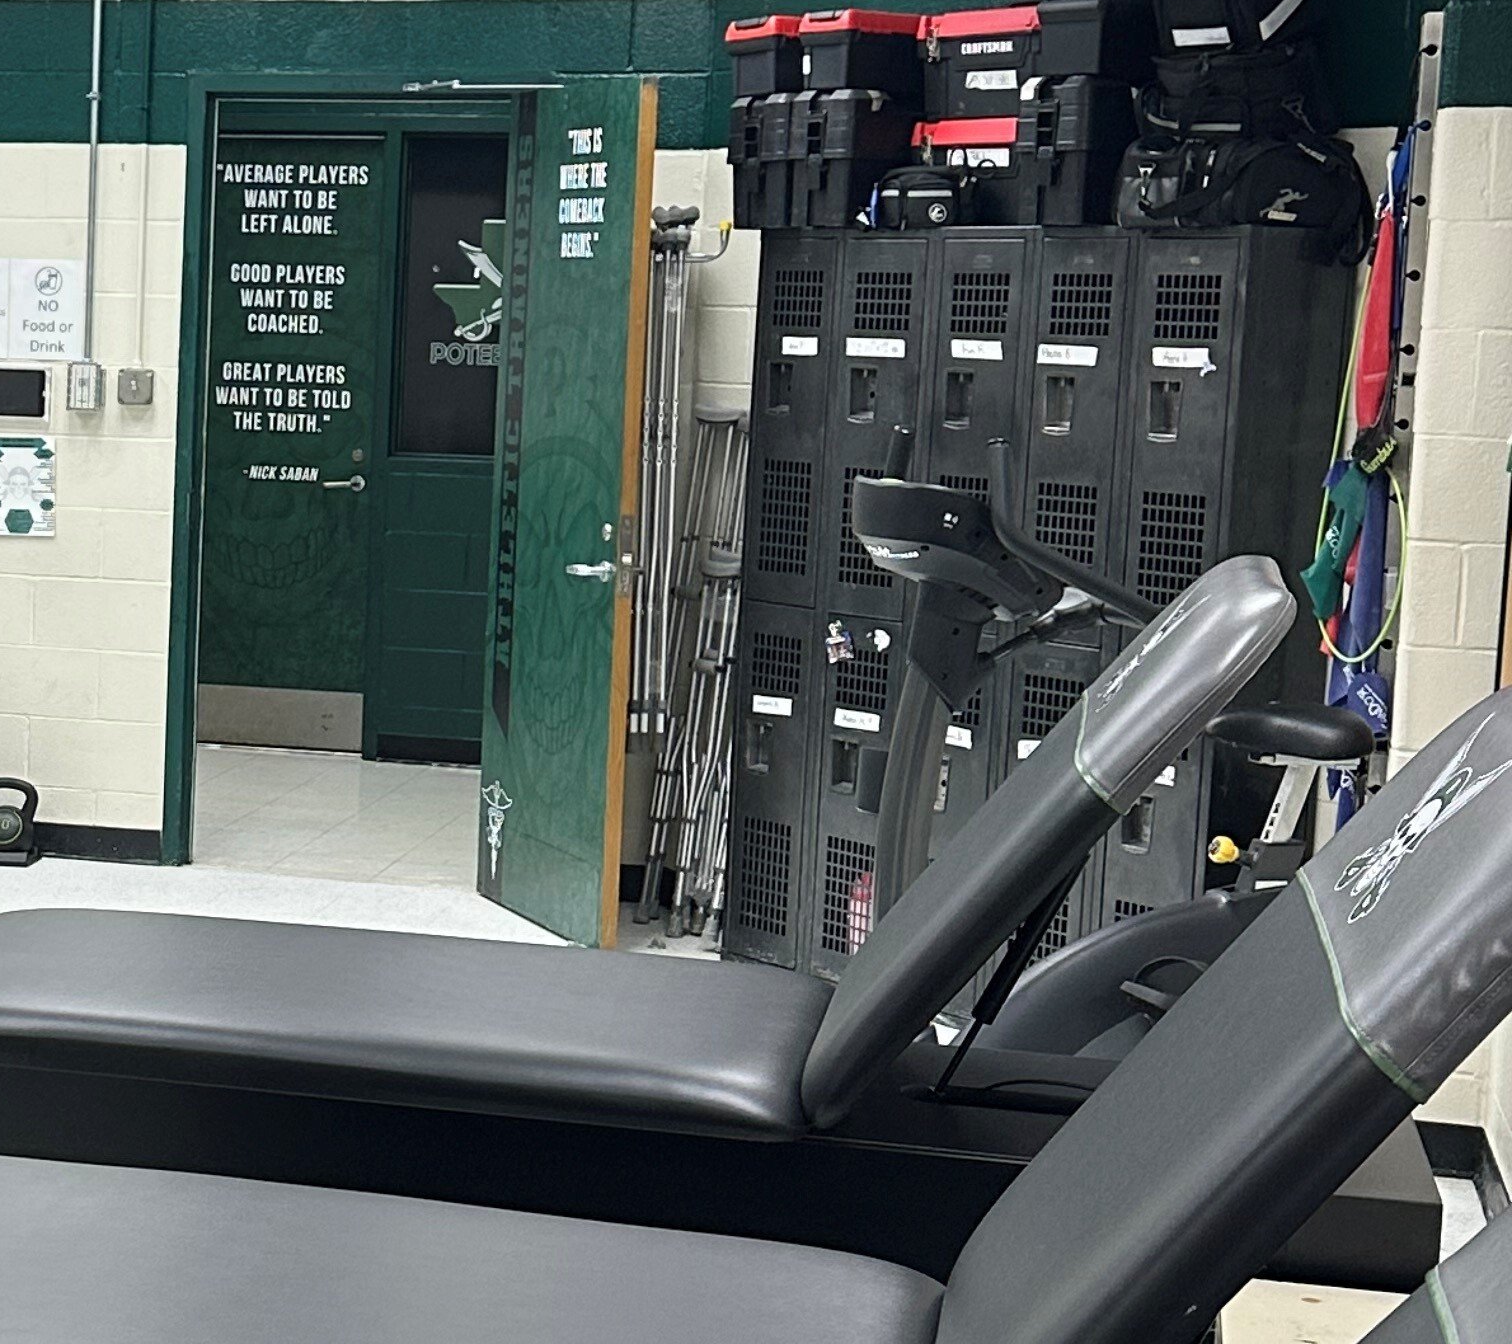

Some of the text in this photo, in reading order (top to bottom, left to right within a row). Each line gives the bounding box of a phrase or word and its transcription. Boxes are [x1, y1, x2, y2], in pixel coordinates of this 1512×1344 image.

[593, 126, 603, 154] IS
[216, 163, 370, 185] "AVERAGE PLAYERS
[559, 161, 608, 190] WHERE THE
[243, 188, 338, 210] WANT TO BE
[558, 197, 606, 224] COMEBACK
[240, 213, 338, 235] LEFT ALONE.
[230, 263, 346, 285] GOOD PLAYERS
[37, 299, 59, 312] NO
[239, 288, 334, 310] WANT TO BE
[22, 319, 74, 333] Food or
[247, 313, 324, 335] COACHED.
[29, 340, 66, 353] Drink
[222, 361, 346, 385] GREAT PLAYERS
[215, 385, 352, 410] WANT TO BE TOLD
[233, 411, 331, 434] THE TRUTH."
[279, 466, 320, 482] SABAN
